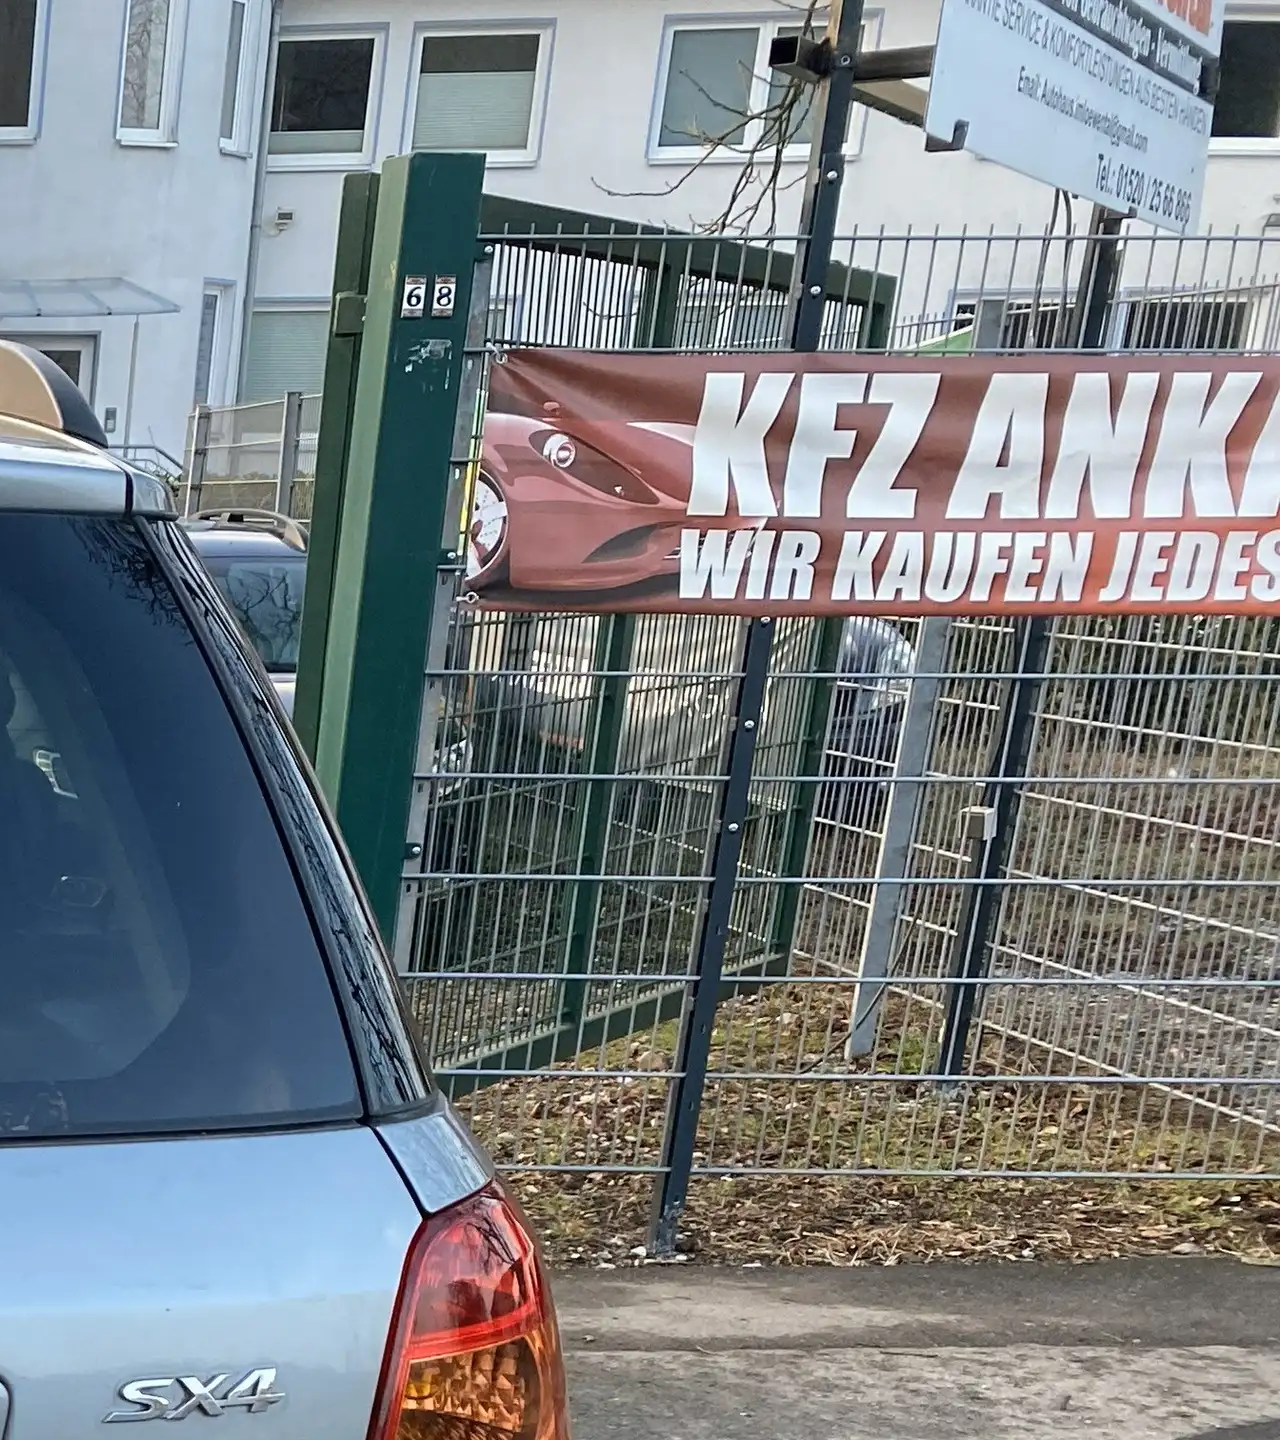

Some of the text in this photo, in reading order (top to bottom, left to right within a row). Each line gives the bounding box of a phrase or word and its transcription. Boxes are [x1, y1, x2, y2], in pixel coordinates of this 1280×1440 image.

[1149, 178, 1163, 214] 25
[685, 371, 941, 519] KFZ
[678, 528, 1280, 603] WIR KAUFEN JEDES
[100, 1366, 286, 1423] SX4
